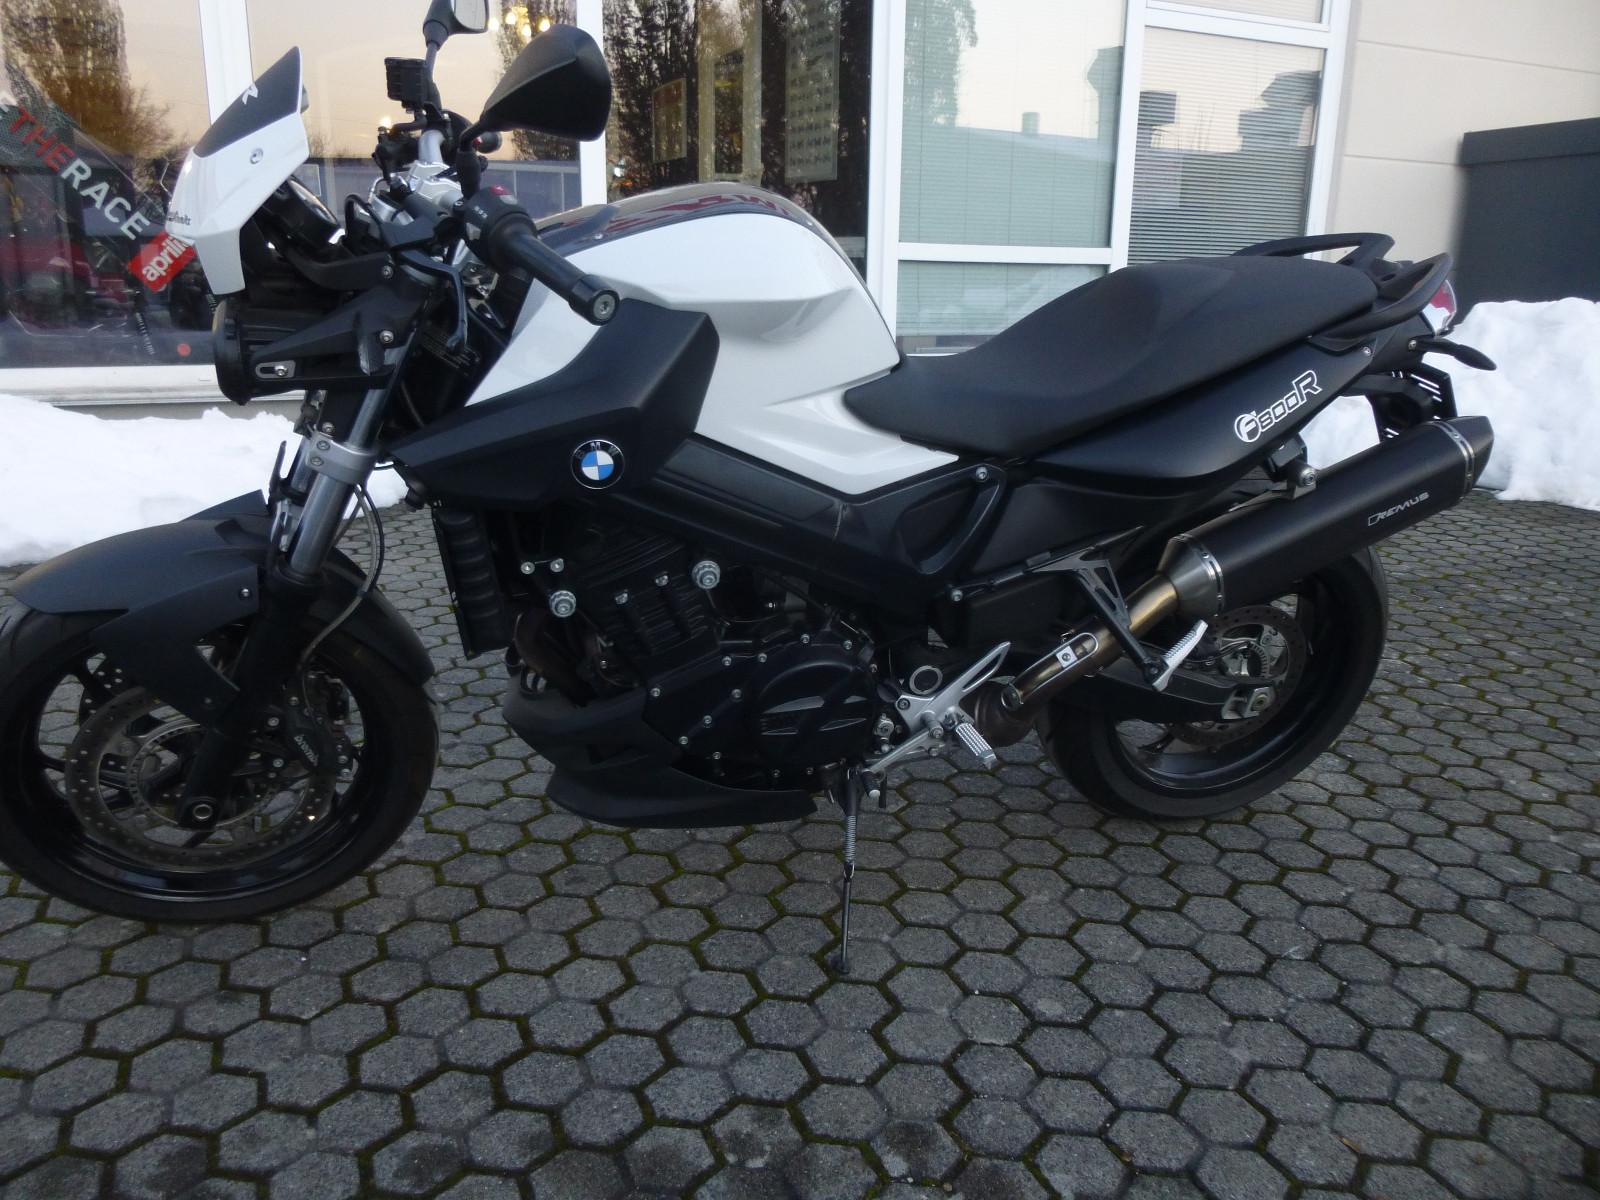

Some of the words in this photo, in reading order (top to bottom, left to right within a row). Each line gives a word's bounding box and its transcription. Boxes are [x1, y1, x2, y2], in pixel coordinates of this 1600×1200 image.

[9, 106, 76, 172] THE
[60, 158, 151, 241] RACE
[142, 235, 190, 282] aprili
[1368, 491, 1430, 527] REMUS
